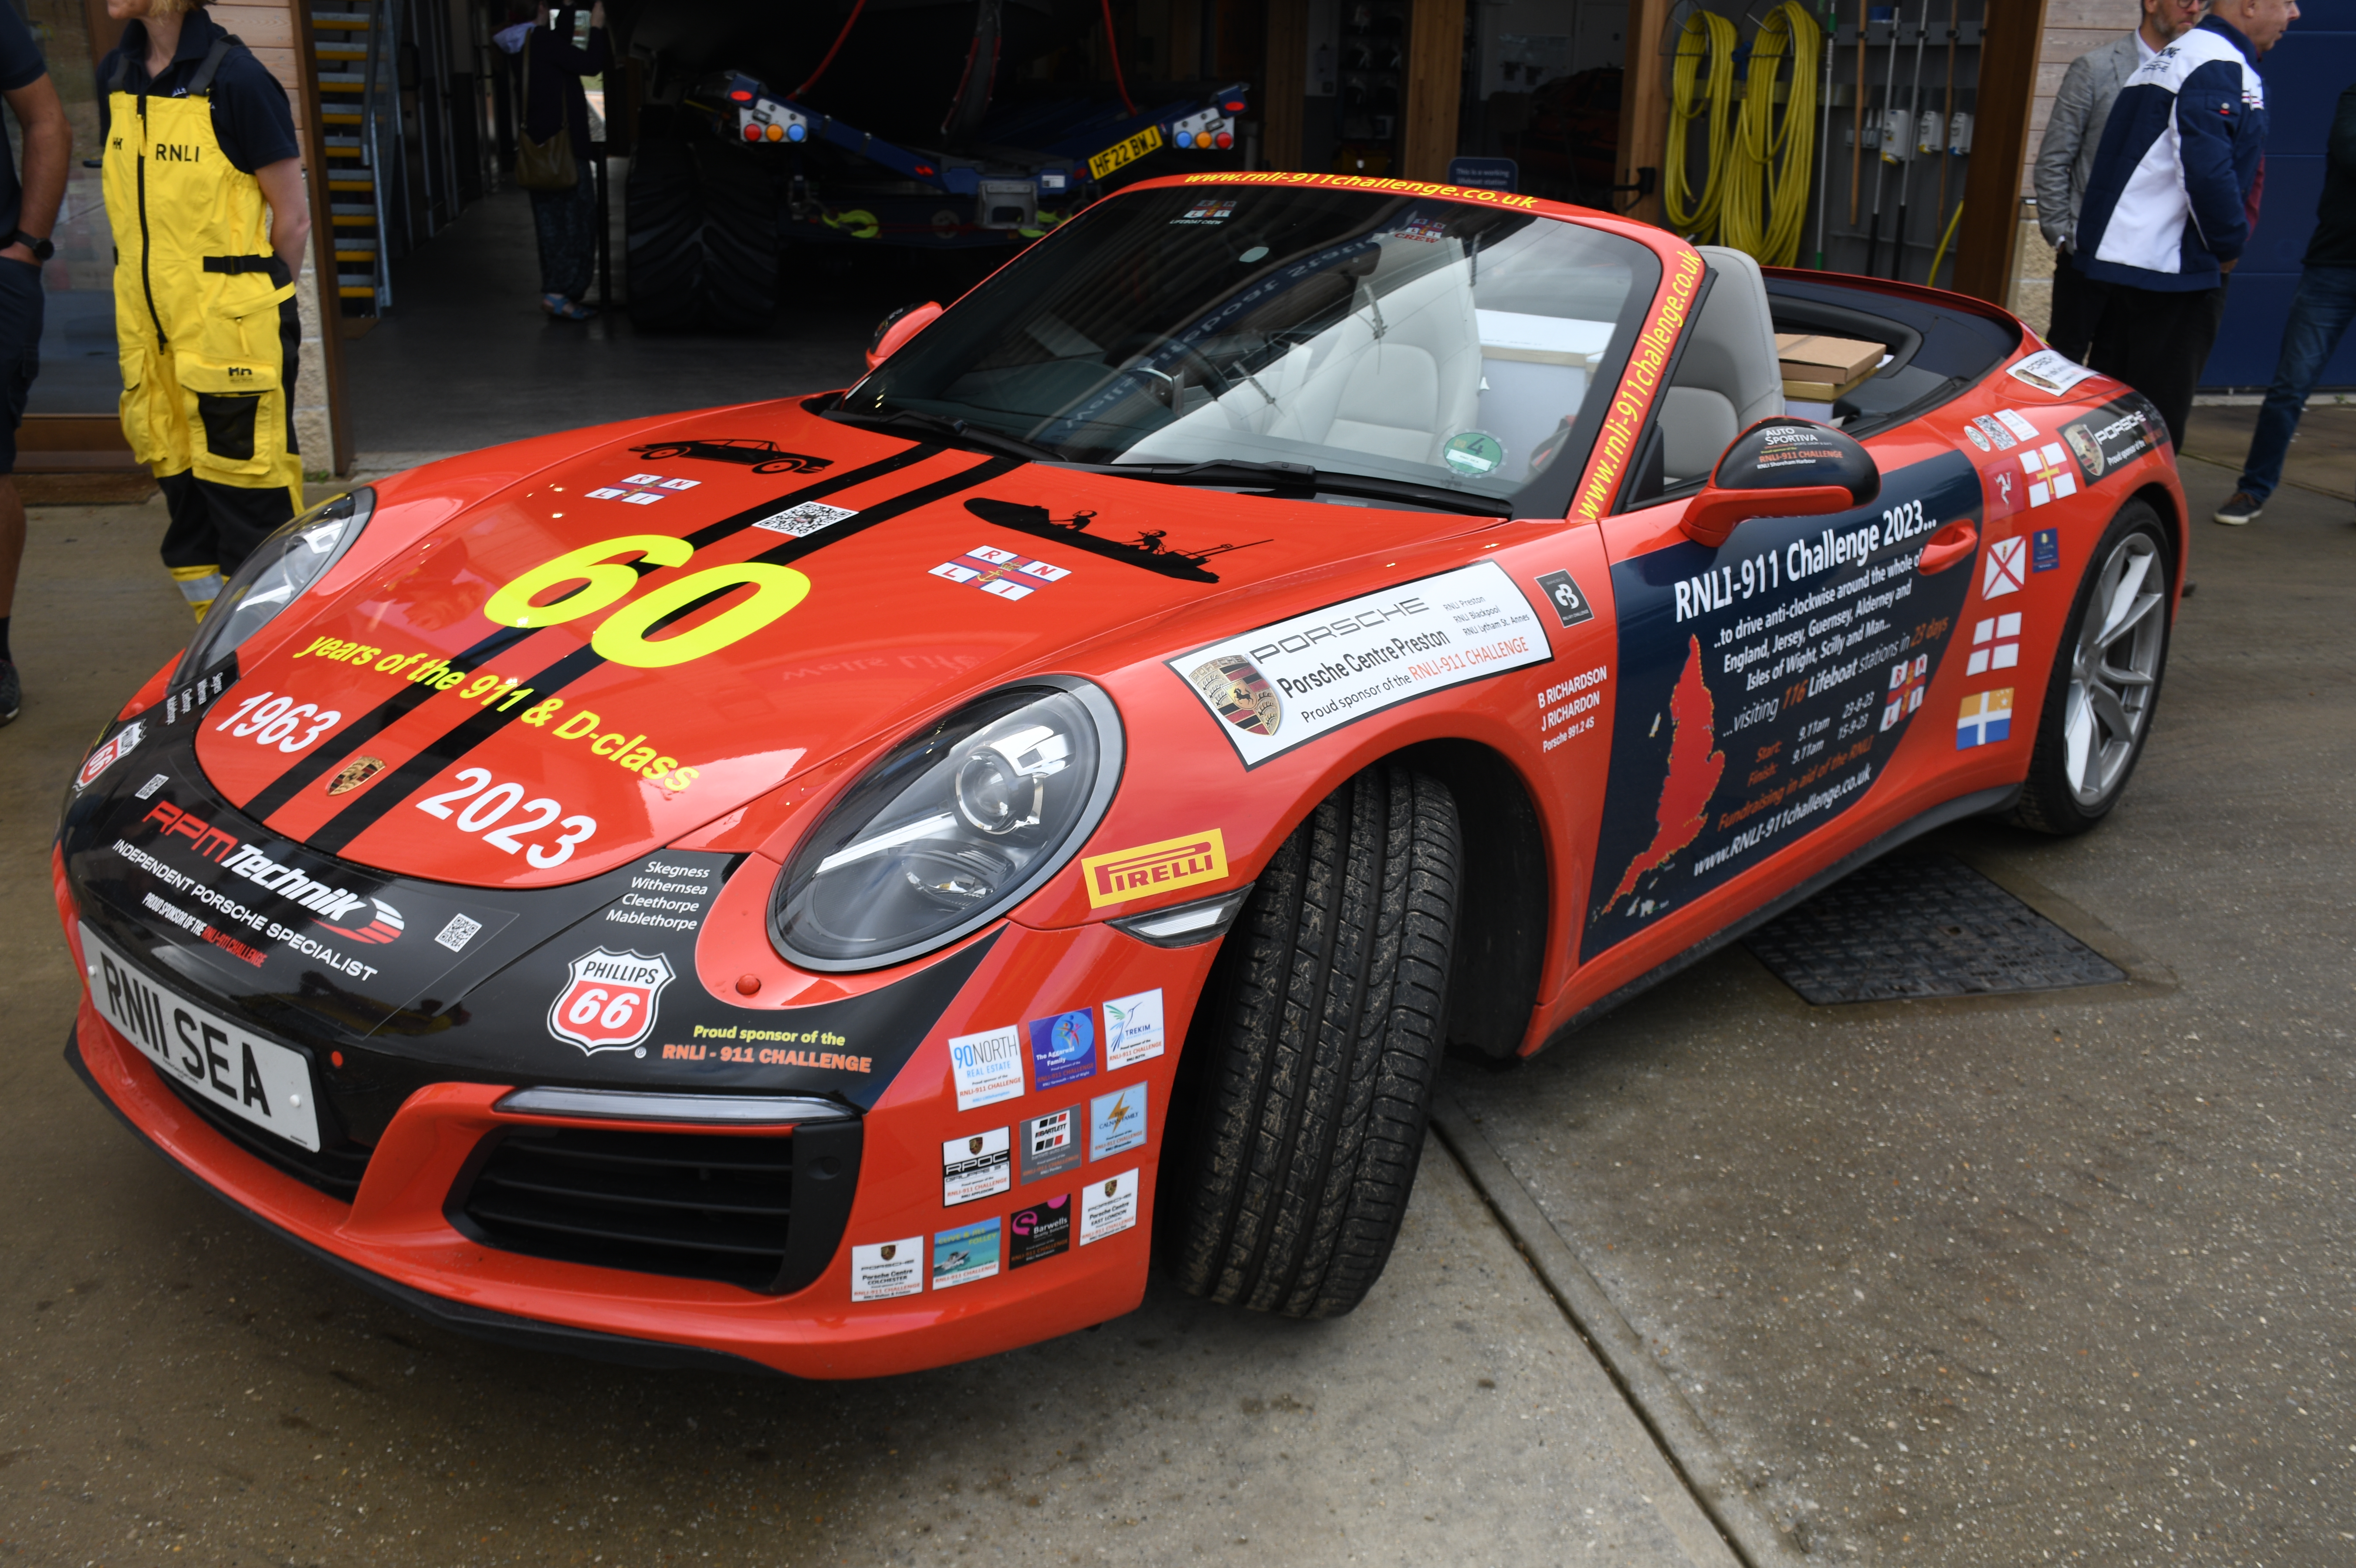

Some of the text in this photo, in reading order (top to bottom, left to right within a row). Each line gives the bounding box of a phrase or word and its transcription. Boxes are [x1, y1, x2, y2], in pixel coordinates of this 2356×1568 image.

[156, 143, 200, 162] RNLI
[1093, 129, 1158, 176] HF22 BWJ
[1185, 172, 1538, 209] www.rnli-911challenge.co.uk
[1395, 233, 1439, 244] CREW
[1578, 250, 1701, 520] www.rnli-911challenge.co.uk
[1765, 434, 1818, 445] SPORTIVA
[1766, 428, 1795, 436] AUTO
[2094, 410, 2146, 445] PORSCHE
[1467, 438, 1485, 455] 4
[1759, 450, 1843, 463] RNLI-911 CHALLENGE
[1674, 499, 1937, 623] RNLI-911 Challenge 2023...
[483, 534, 811, 668] 60
[1443, 595, 1486, 611] RNLI Preston
[1453, 605, 1501, 623] RNLI Blackpool
[1735, 616, 1763, 639] drive
[1765, 589, 1835, 628] anti-clockwise
[1836, 574, 1869, 599] around
[1871, 566, 1885, 585] the
[1887, 557, 1912, 578] whole
[1249, 597, 1430, 664] PORSCHE
[1462, 613, 1530, 636] RNLI Lytham St. Annes
[1723, 578, 1912, 673] England, Jersey, Guernsey, Alderney and
[1191, 655, 1247, 682] PORSCHE
[1276, 629, 1451, 699] Porsche Centre Preston
[1746, 669, 1770, 691] Isles
[1772, 659, 1785, 680] of
[1786, 646, 1818, 674] Wight,
[1820, 633, 1845, 659] Scilly
[1846, 625, 1863, 646] and
[1783, 679, 1809, 710] 116
[1807, 657, 1858, 698] Lifeboat
[1858, 639, 1898, 673] stations
[1899, 632, 1910, 653] in
[1910, 623, 1926, 648] 23
[1926, 616, 1949, 640] days
[1300, 636, 1529, 723] Proud sponsor of the RNLI-911 CHALLENGE
[1538, 666, 1608, 709] B RICHARDSON
[215, 691, 342, 754] 1963
[293, 636, 701, 792] years of the 911 & D-class
[1541, 691, 1600, 732] J RICHARDON
[1797, 717, 1830, 741] 9.11am
[1842, 691, 1875, 720] 23-8-23
[1543, 716, 1594, 753] Porsche 991.2 4S
[1791, 740, 1824, 765] 9.11am
[1837, 713, 1869, 740] 15-9-23
[1717, 735, 1874, 831] Fundraising in aid of the RNLI
[416, 767, 598, 870] 2023
[1693, 762, 1872, 877] www.RNLI-911challenge.co.uk
[142, 800, 368, 922] RPM Technik
[645, 861, 710, 878] Skegness
[1094, 841, 1213, 896] PIRELLI
[621, 893, 700, 913] Cleethorpe
[630, 877, 708, 895] Withernsea
[112, 839, 378, 982] INDEPENDENT PORSCHE SPECIALIST
[606, 909, 697, 931] Mablethorpe
[142, 892, 267, 968] PROUD SPONSOR OF THE RNLI-911 CHALLENGE
[582, 961, 659, 984] PHILLIPS
[568, 988, 641, 1029] 66
[693, 1025, 846, 1046] Proud sponsor of the
[1125, 1024, 1150, 1036] TREKIM
[173, 1007, 272, 1119] SEA
[662, 1044, 706, 1061] RNLI
[719, 1046, 755, 1064] 911
[758, 1048, 873, 1074] CHALLENGE
[967, 1061, 1011, 1078] REAL ESTATE
[1047, 1058, 1066, 1066] Family
[1048, 1046, 1075, 1058] Aggarwal
[960, 1077, 1021, 1097] RNLI-911 CHALLENGE
[1040, 1123, 1067, 1136] BARTLETT
[1122, 1112, 1138, 1122] FAMILY
[946, 1151, 1008, 1175] RPOC
[1034, 1217, 1067, 1234] Barwells
[1105, 1209, 1127, 1221] LONDON
[867, 1275, 907, 1285] COLCHESTER
